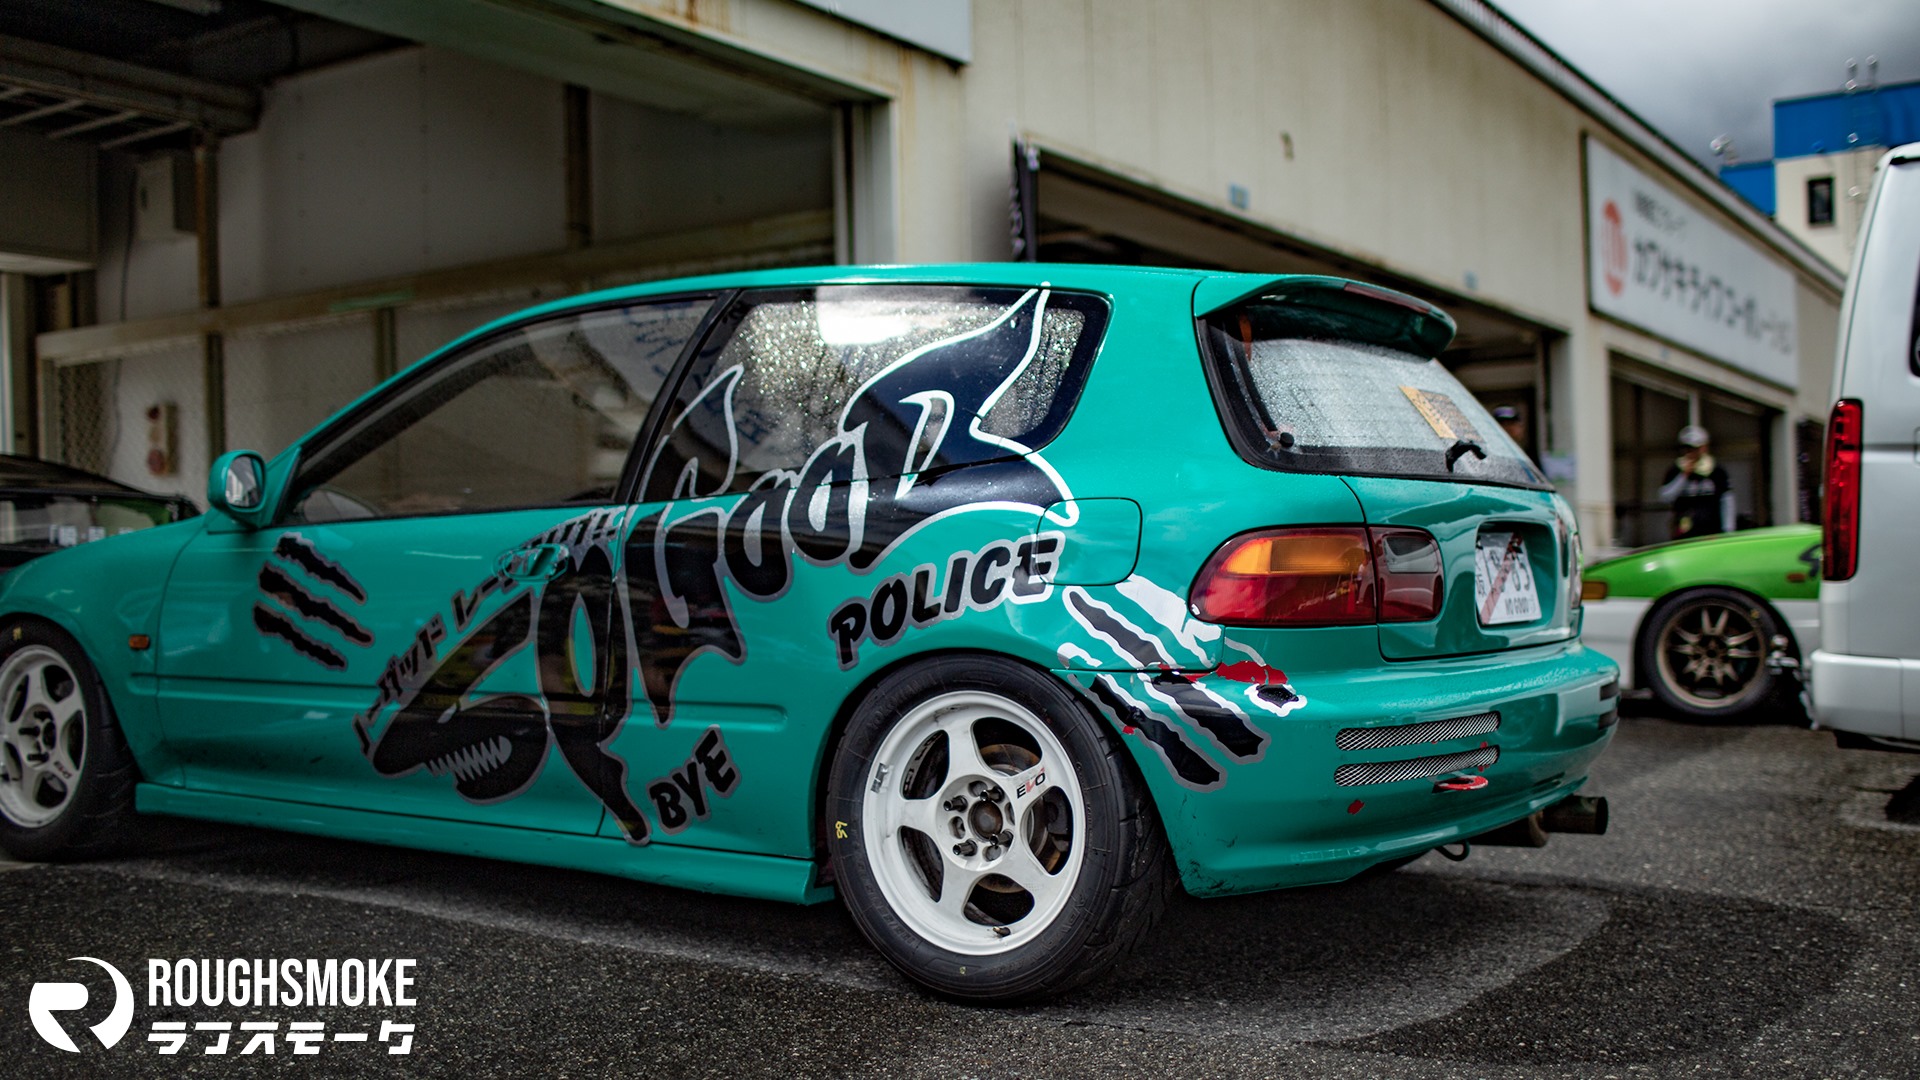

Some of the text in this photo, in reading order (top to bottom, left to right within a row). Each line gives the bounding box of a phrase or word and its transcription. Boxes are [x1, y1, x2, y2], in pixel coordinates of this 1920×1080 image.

[829, 534, 1062, 667] POLICE
[648, 727, 738, 832] BYE
[1016, 768, 1047, 799] EVO
